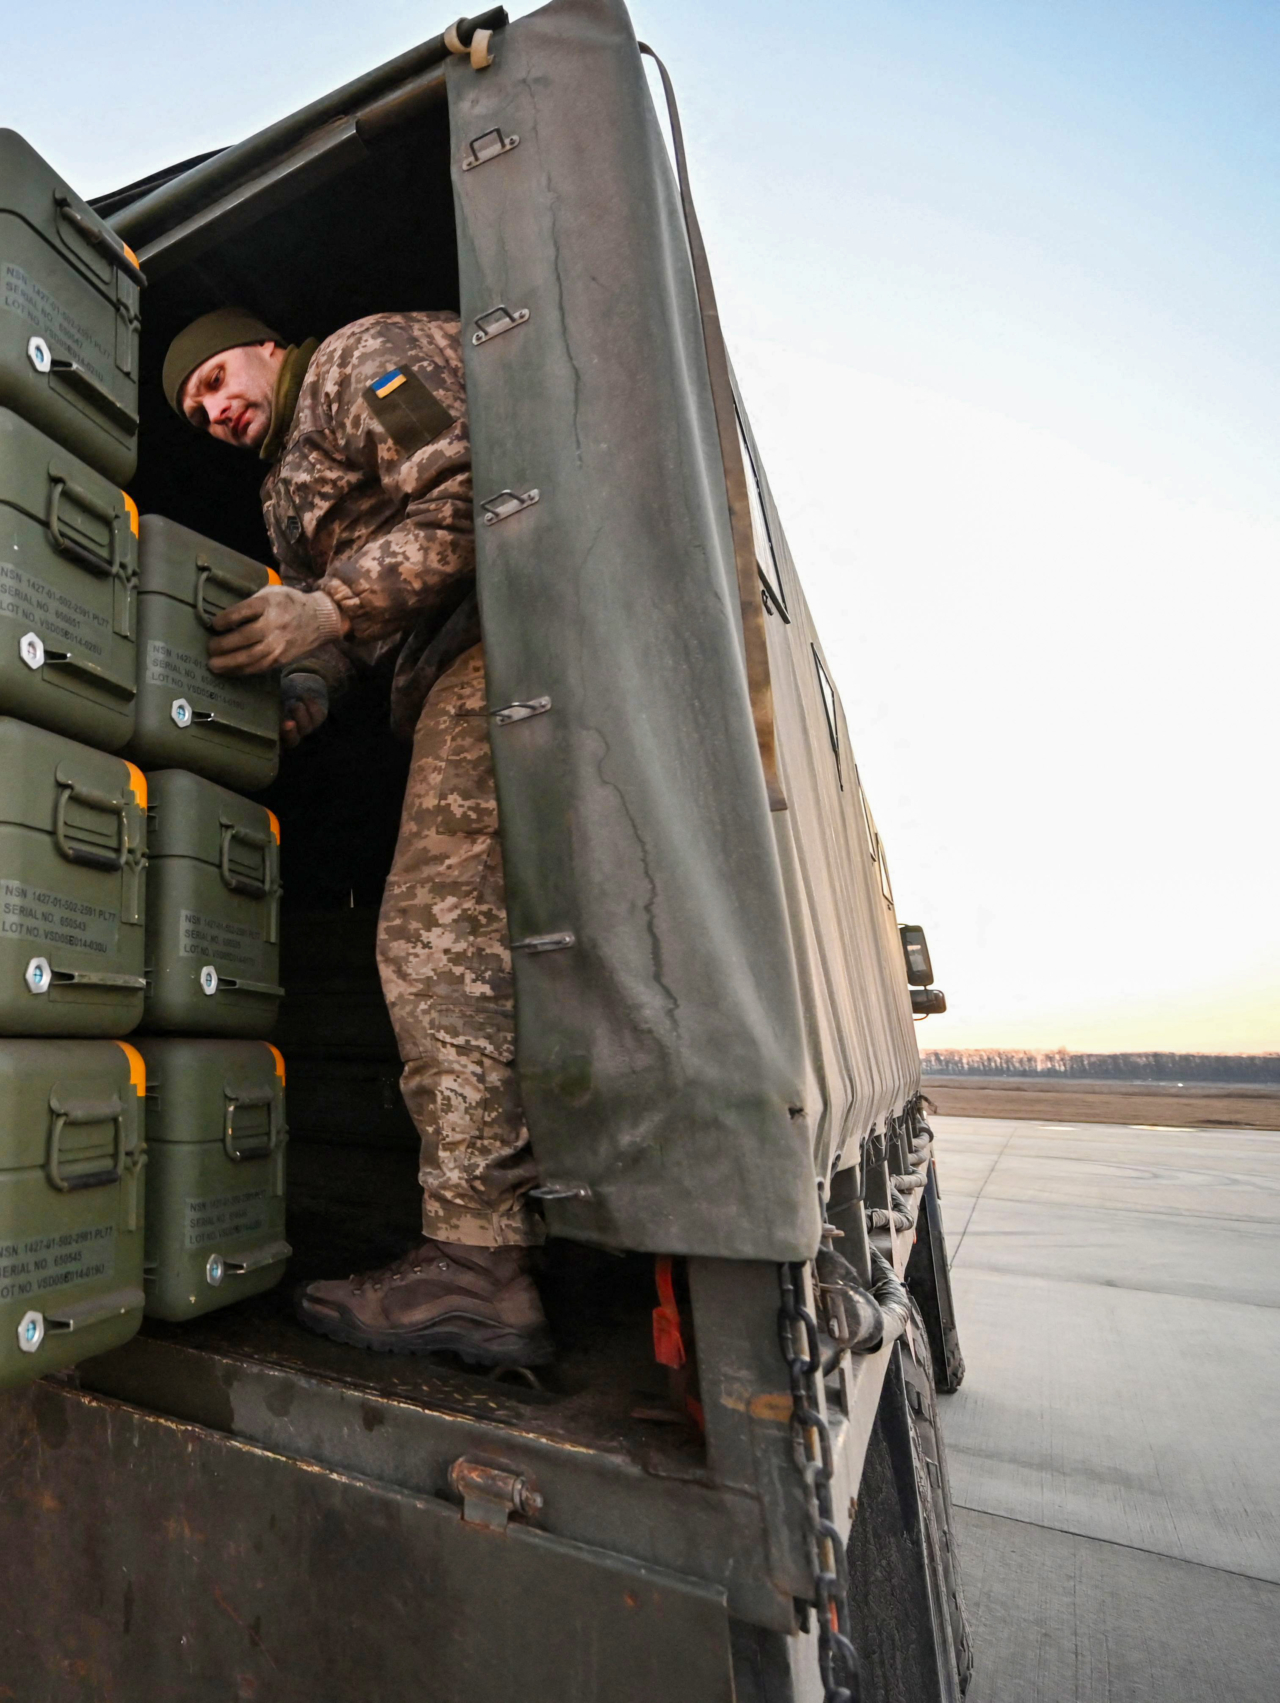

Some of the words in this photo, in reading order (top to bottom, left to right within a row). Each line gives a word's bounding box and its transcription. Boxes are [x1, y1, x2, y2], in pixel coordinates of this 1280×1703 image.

[6, 267, 28, 285] NSN
[6, 282, 38, 309] SERIAL
[5, 297, 25, 314] LOT
[1, 566, 22, 582] NSN
[0, 584, 34, 606] SERIAL
[0, 600, 19, 614] LOT
[153, 646, 171, 657] NSN
[152, 659, 181, 674] SERIAL
[152, 673, 168, 682] LOT
[5, 886, 27, 899] NSN
[33, 892, 96, 917] 1427-01-502-2591
[98, 909, 116, 922] PL77
[4, 903, 39, 920] SERIAL
[42, 912, 55, 924] NO.
[185, 915, 201, 924] NSN
[2, 921, 24, 934] LOT
[185, 930, 210, 942] SERIAL
[184, 944, 199, 953] LOT
[95, 1226, 113, 1239] PL77
